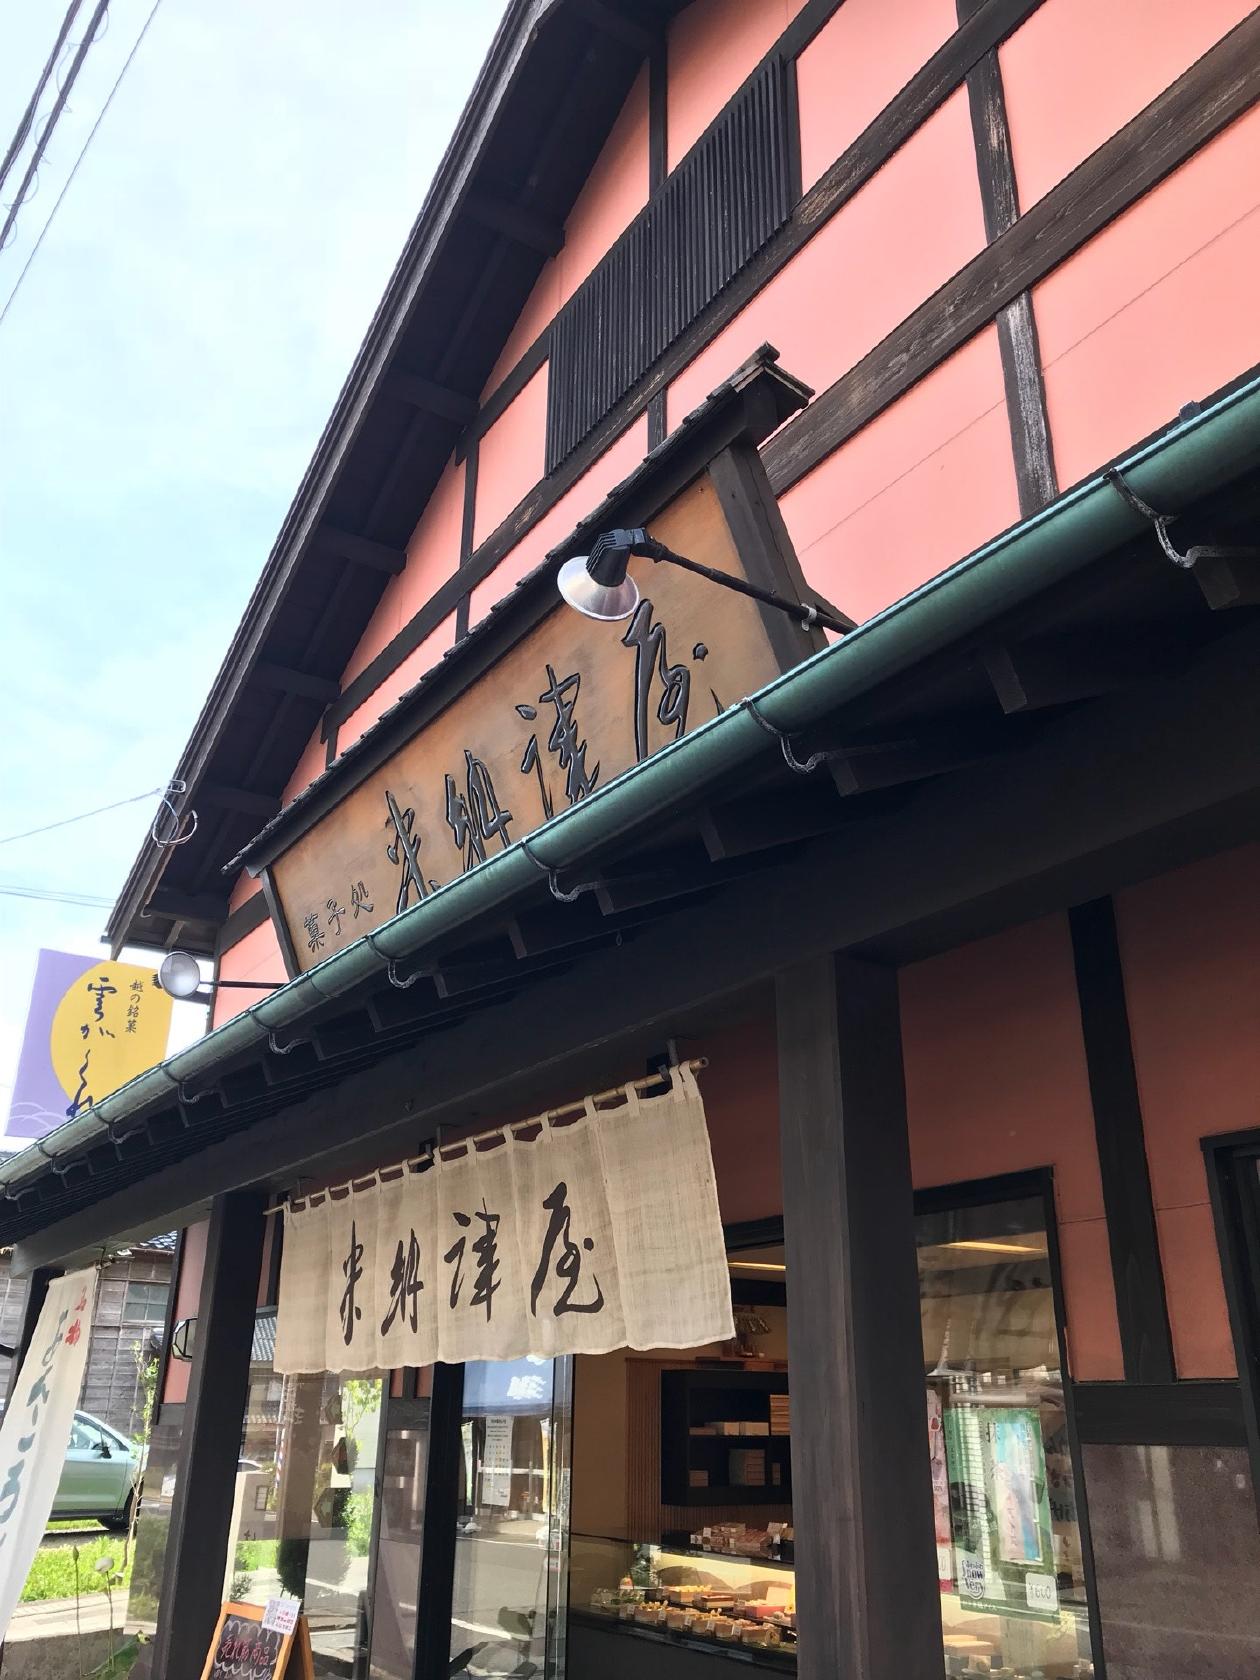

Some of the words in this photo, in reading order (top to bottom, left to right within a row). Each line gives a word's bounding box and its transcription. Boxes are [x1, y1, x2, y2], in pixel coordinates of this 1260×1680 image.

[303, 881, 375, 953] 菓子処
[125, 980, 144, 1034] 越の銘菓
[339, 1181, 605, 1347] 米納津屋
